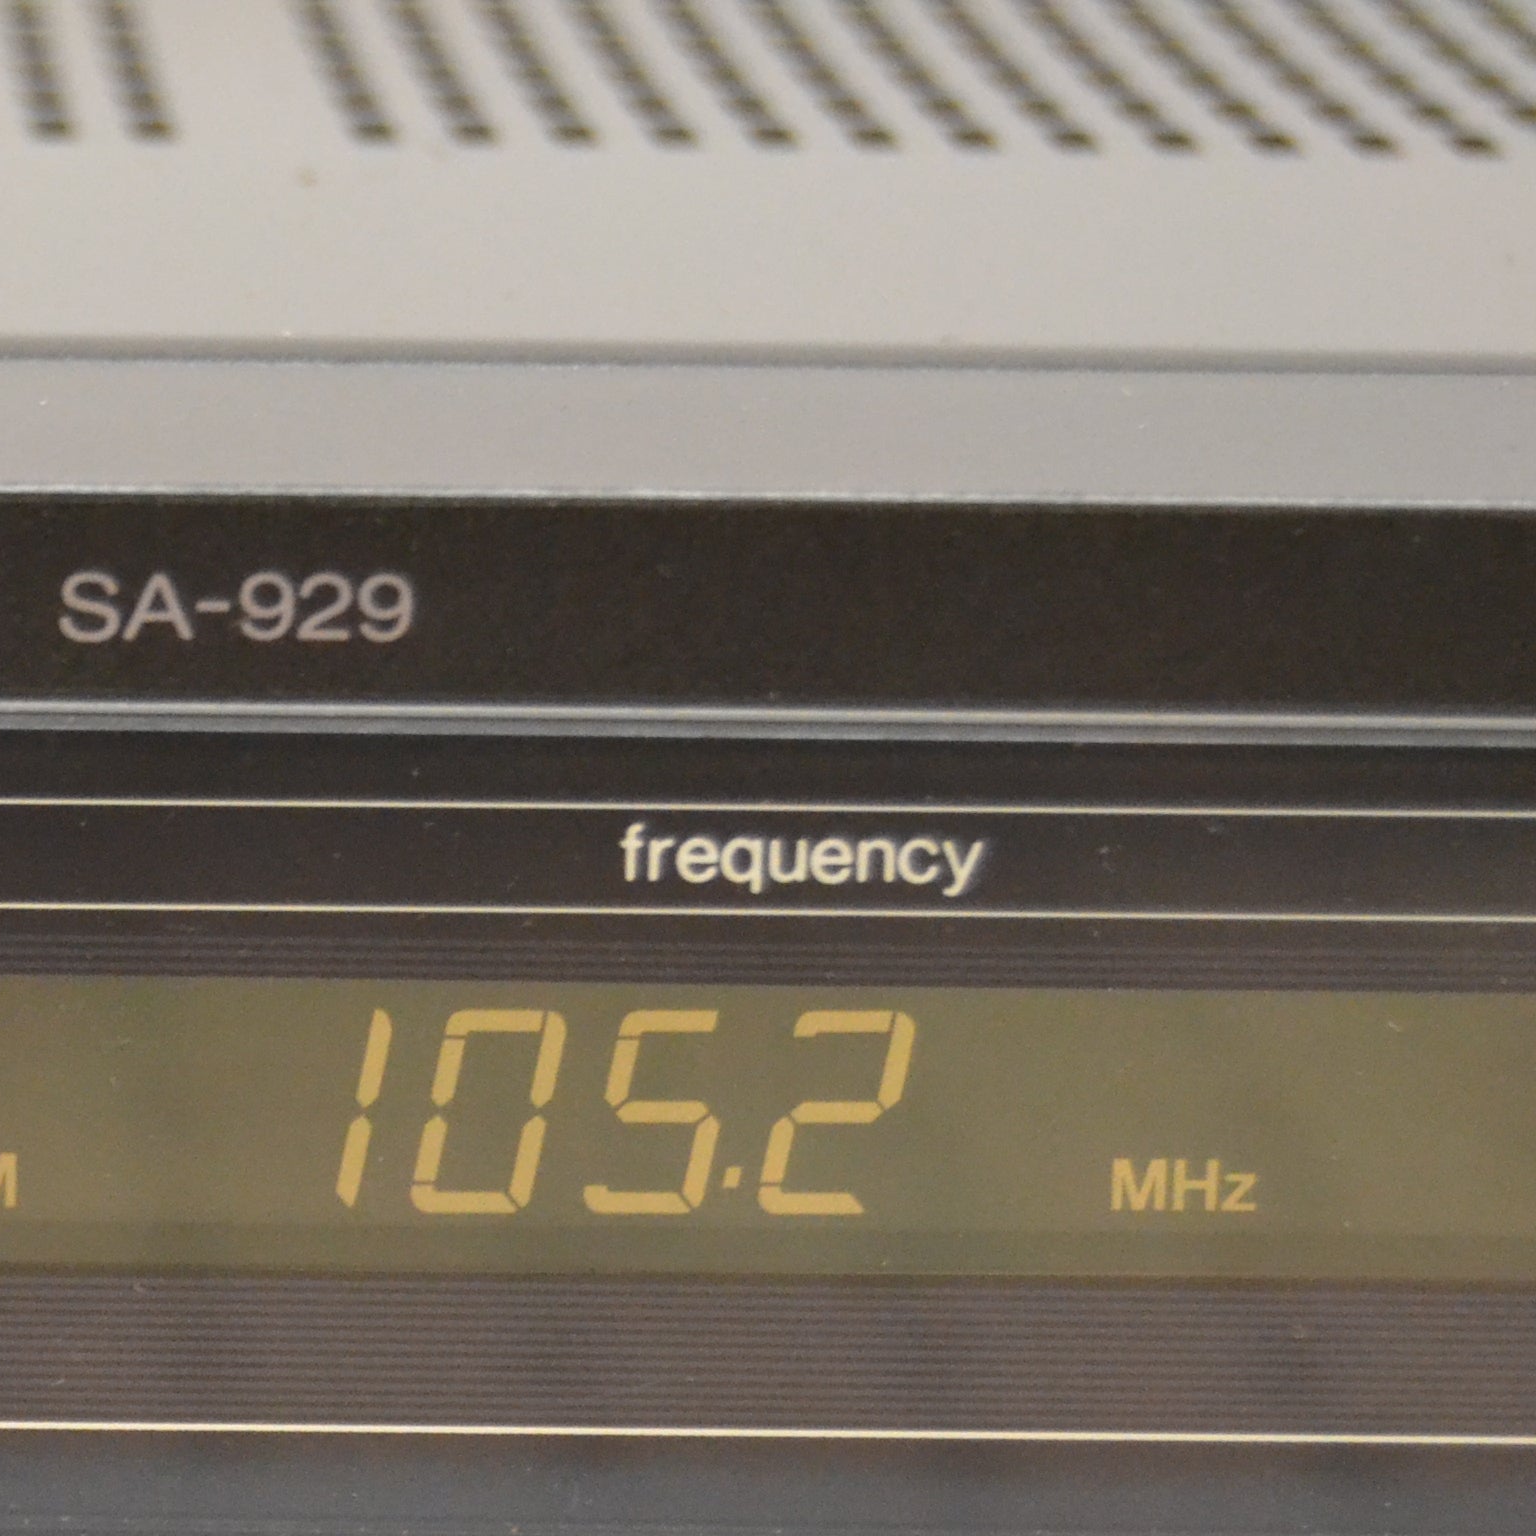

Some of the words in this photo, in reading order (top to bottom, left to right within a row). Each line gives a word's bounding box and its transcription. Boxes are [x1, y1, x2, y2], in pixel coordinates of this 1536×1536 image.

[57, 570, 416, 644] SA-929
[619, 821, 985, 898] frequency
[334, 1008, 917, 1217] 105.2
[1110, 1157, 1257, 1213] MHz
